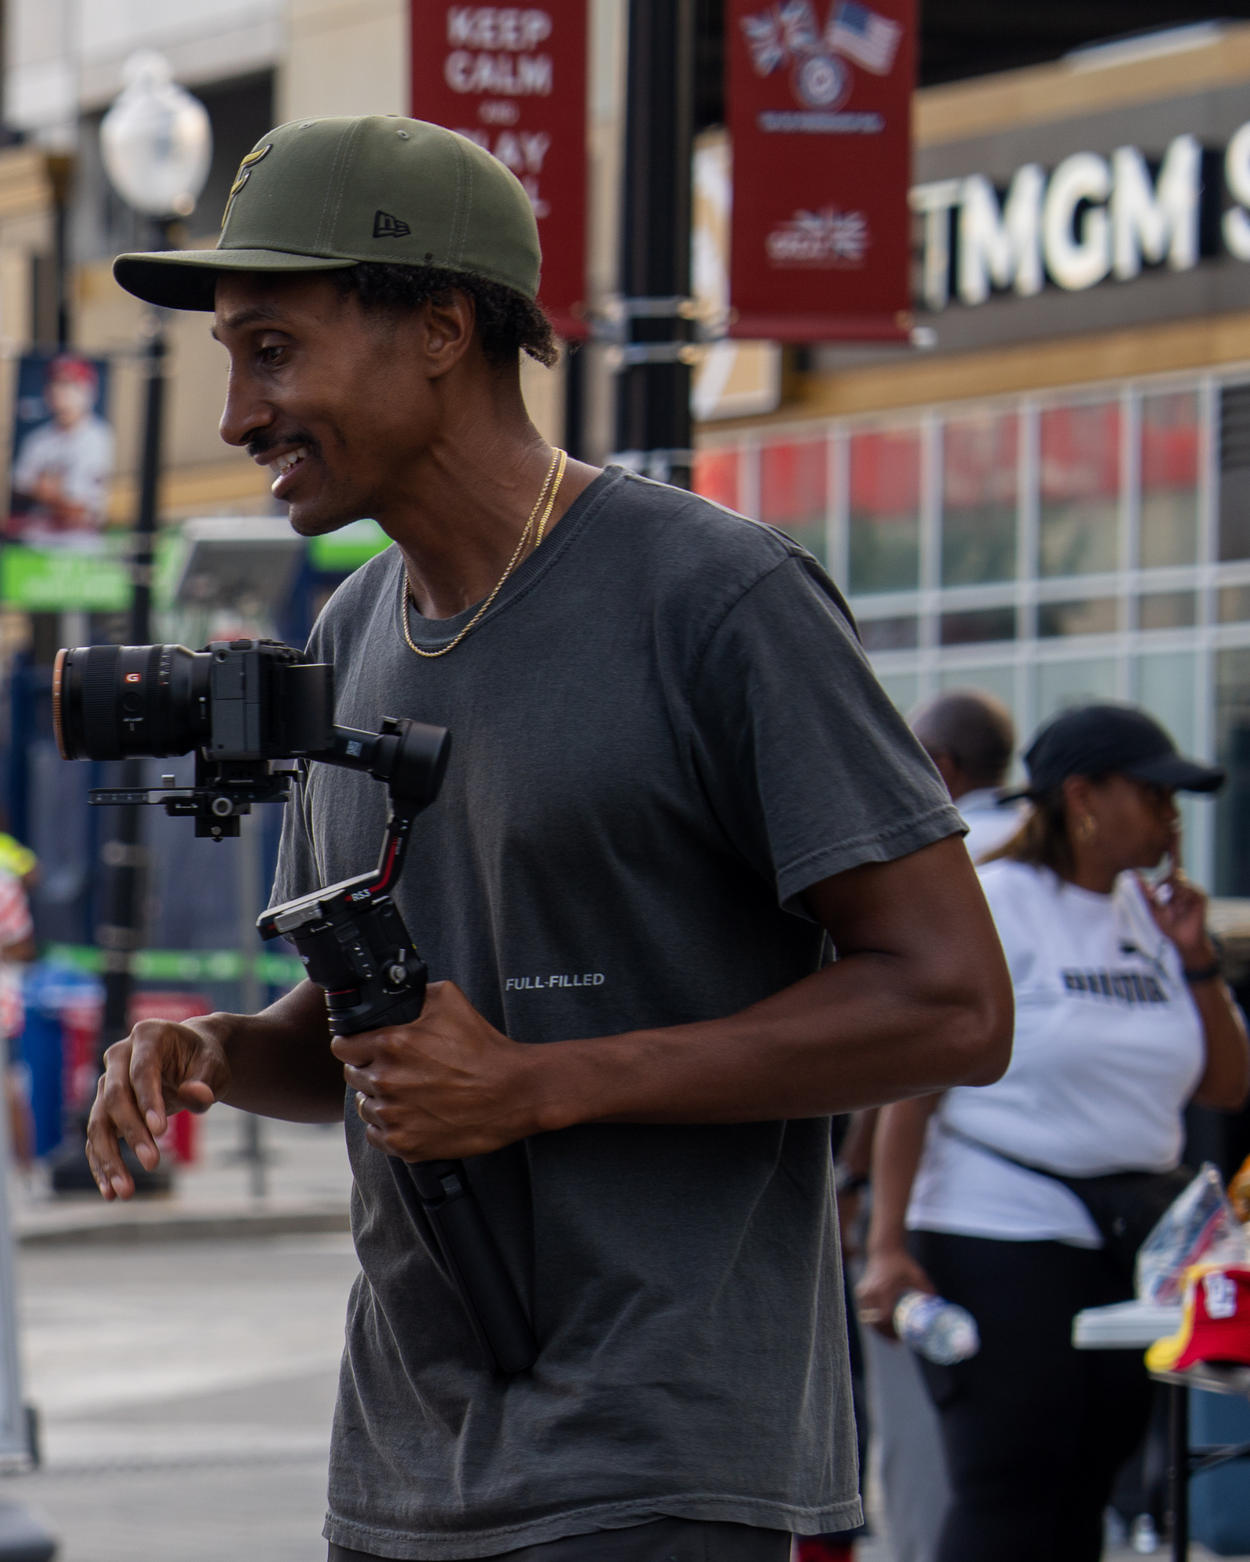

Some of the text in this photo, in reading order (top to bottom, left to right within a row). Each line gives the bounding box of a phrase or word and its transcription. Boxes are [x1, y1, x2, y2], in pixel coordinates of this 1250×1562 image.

[447, 8, 552, 49] KEEP
[445, 52, 553, 95] CALM
[505, 973, 605, 991] FULL-FILLED
